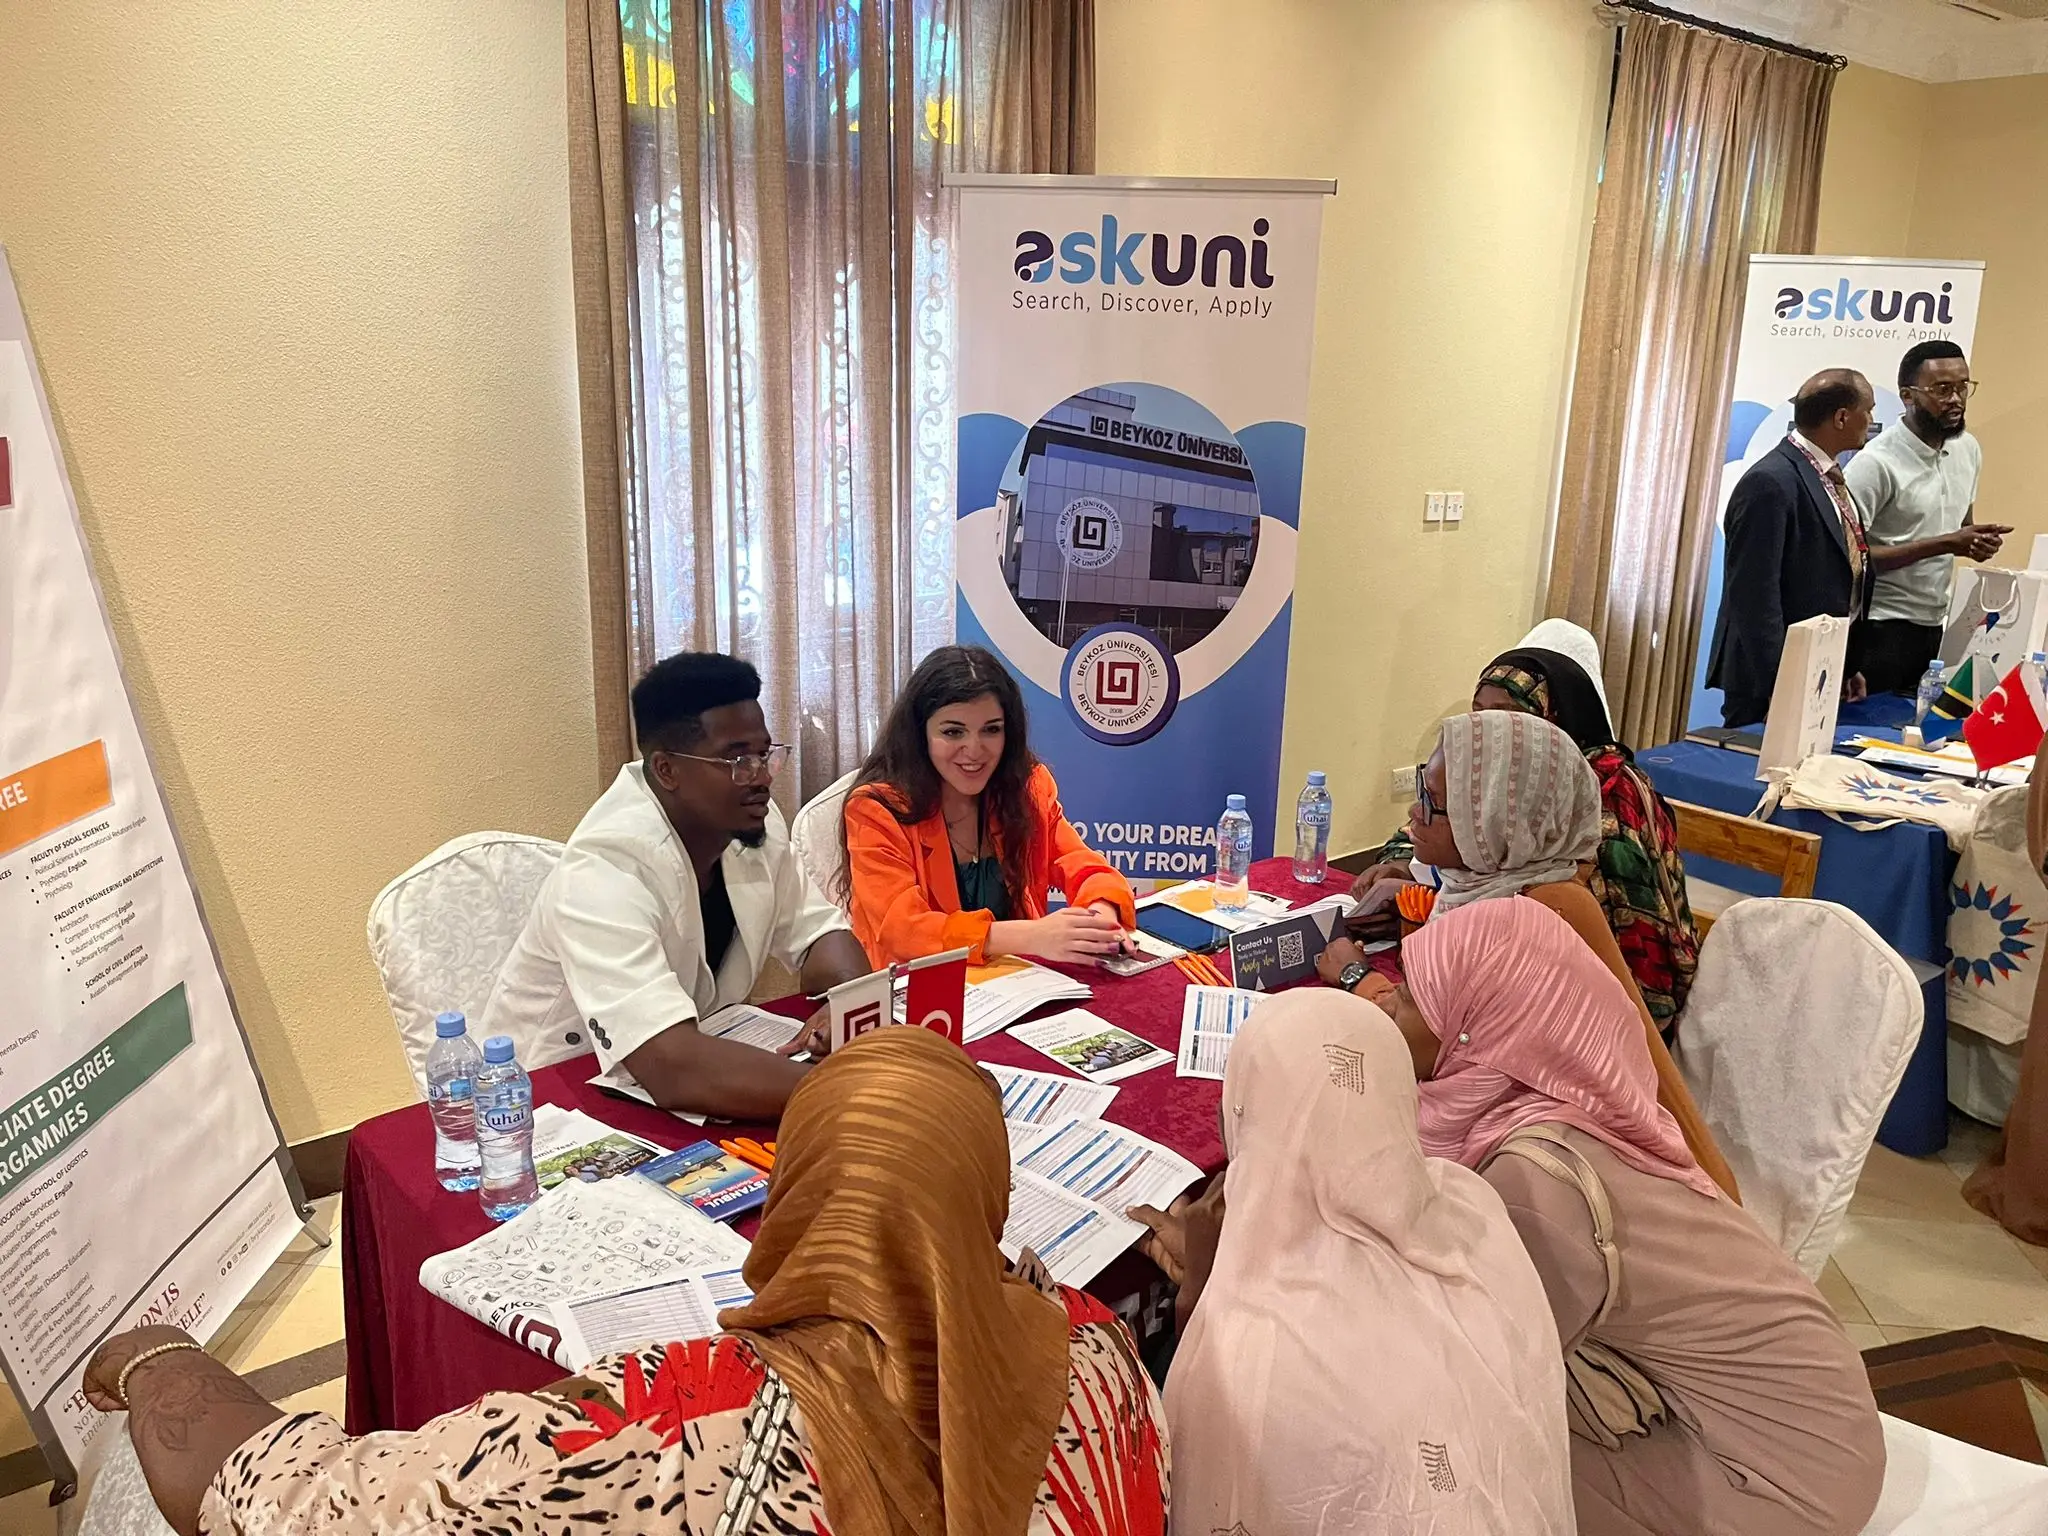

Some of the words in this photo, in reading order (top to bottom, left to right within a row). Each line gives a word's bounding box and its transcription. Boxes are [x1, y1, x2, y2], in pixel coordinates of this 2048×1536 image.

[1013, 214, 1274, 289] askuni
[1012, 290, 1091, 314] Search,
[1101, 292, 1198, 316] Discover,
[1208, 295, 1273, 319] Apply
[1774, 278, 1953, 325] askuni
[1770, 323, 1826, 339] Search,
[1833, 326, 1901, 340] Discover,
[1110, 420, 1174, 450] BEYKOZ
[1082, 544, 1118, 566] UNIVERSITY
[1077, 643, 1105, 677] BEYKOZ
[1077, 693, 1106, 725] BEYKOZ
[1107, 695, 1155, 727] UNIVERSITY
[31, 848, 55, 865] FACULTY
[54, 843, 62, 853] OF
[62, 835, 82, 849] SOCIAL
[82, 821, 110, 840] SCIENCES
[1070, 821, 1088, 841] O
[1093, 823, 1155, 844] YOUR
[1159, 825, 1218, 847] DREA
[35, 861, 56, 877] Political
[55, 852, 75, 866] Science
[39, 869, 69, 888] Psychology
[67, 859, 88, 875] English
[1144, 852, 1208, 874] FROM
[44, 880, 74, 899] Psychology
[53, 904, 78, 922] FACULTY
[77, 899, 86, 909] OF
[85, 880, 123, 905] ENGINEERING
[122, 874, 133, 885] AND
[1236, 939, 1262, 952] Contact
[1263, 936, 1273, 945] Us
[104, 966, 113, 976] OF
[18, 1029, 40, 1045] Design
[48, 1045, 116, 1109] DEGREE
[491, 1108, 525, 1126] uhai
[30, 1177, 57, 1199] SCHOOL
[30, 1198, 55, 1219] Services
[35, 1209, 60, 1229] Services
[161, 1281, 181, 1309] IS
[73, 1408, 94, 1436] NOT
